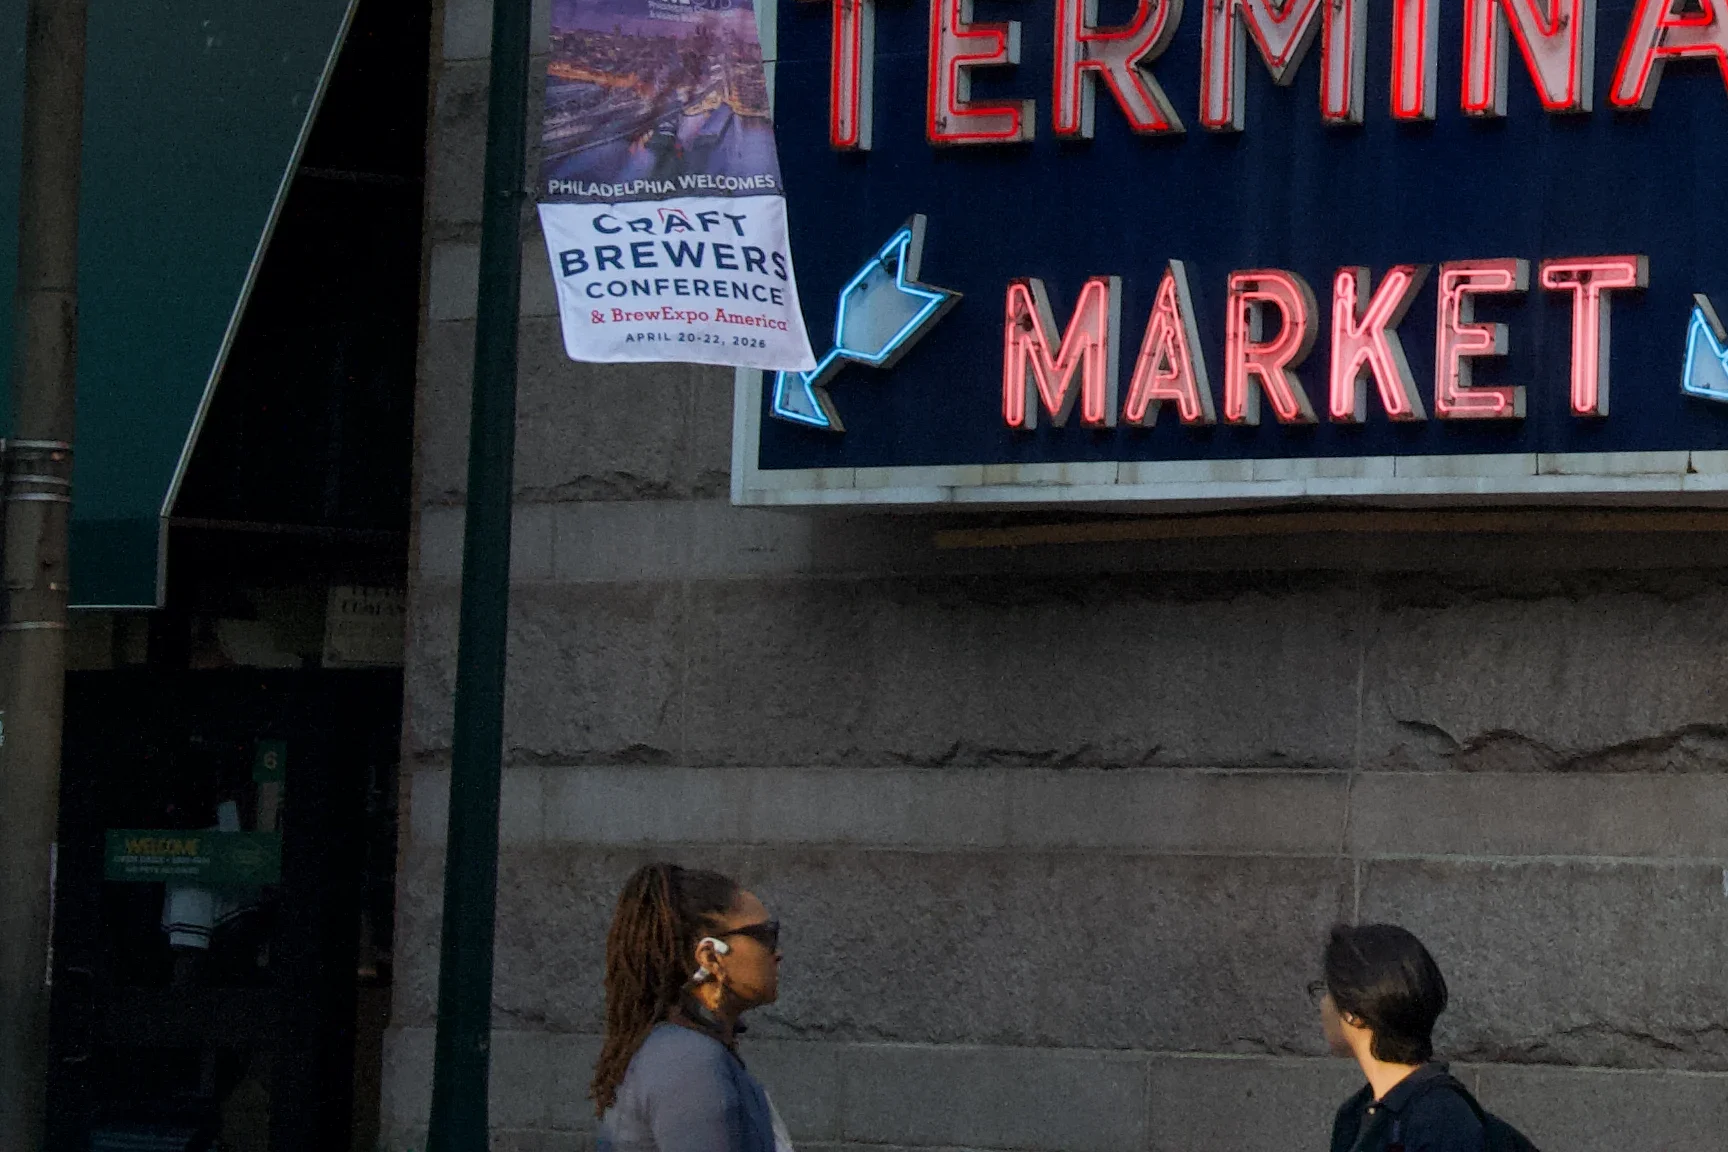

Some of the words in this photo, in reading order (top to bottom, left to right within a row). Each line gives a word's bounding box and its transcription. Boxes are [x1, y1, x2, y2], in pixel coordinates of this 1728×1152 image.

[548, 179, 677, 197] PHILADELPHIA
[678, 174, 776, 191] WELCOMES
[591, 209, 747, 237] CRAFT
[558, 240, 788, 282] BREWERS
[585, 278, 785, 306] CONFERENCE
[590, 309, 606, 325] &
[611, 306, 710, 325] BrewExpo
[714, 307, 788, 332] America
[624, 332, 672, 344] APRIL
[678, 332, 726, 346] 20-22,
[732, 336, 767, 349] 2026
[1000, 254, 1649, 431] MARKET
